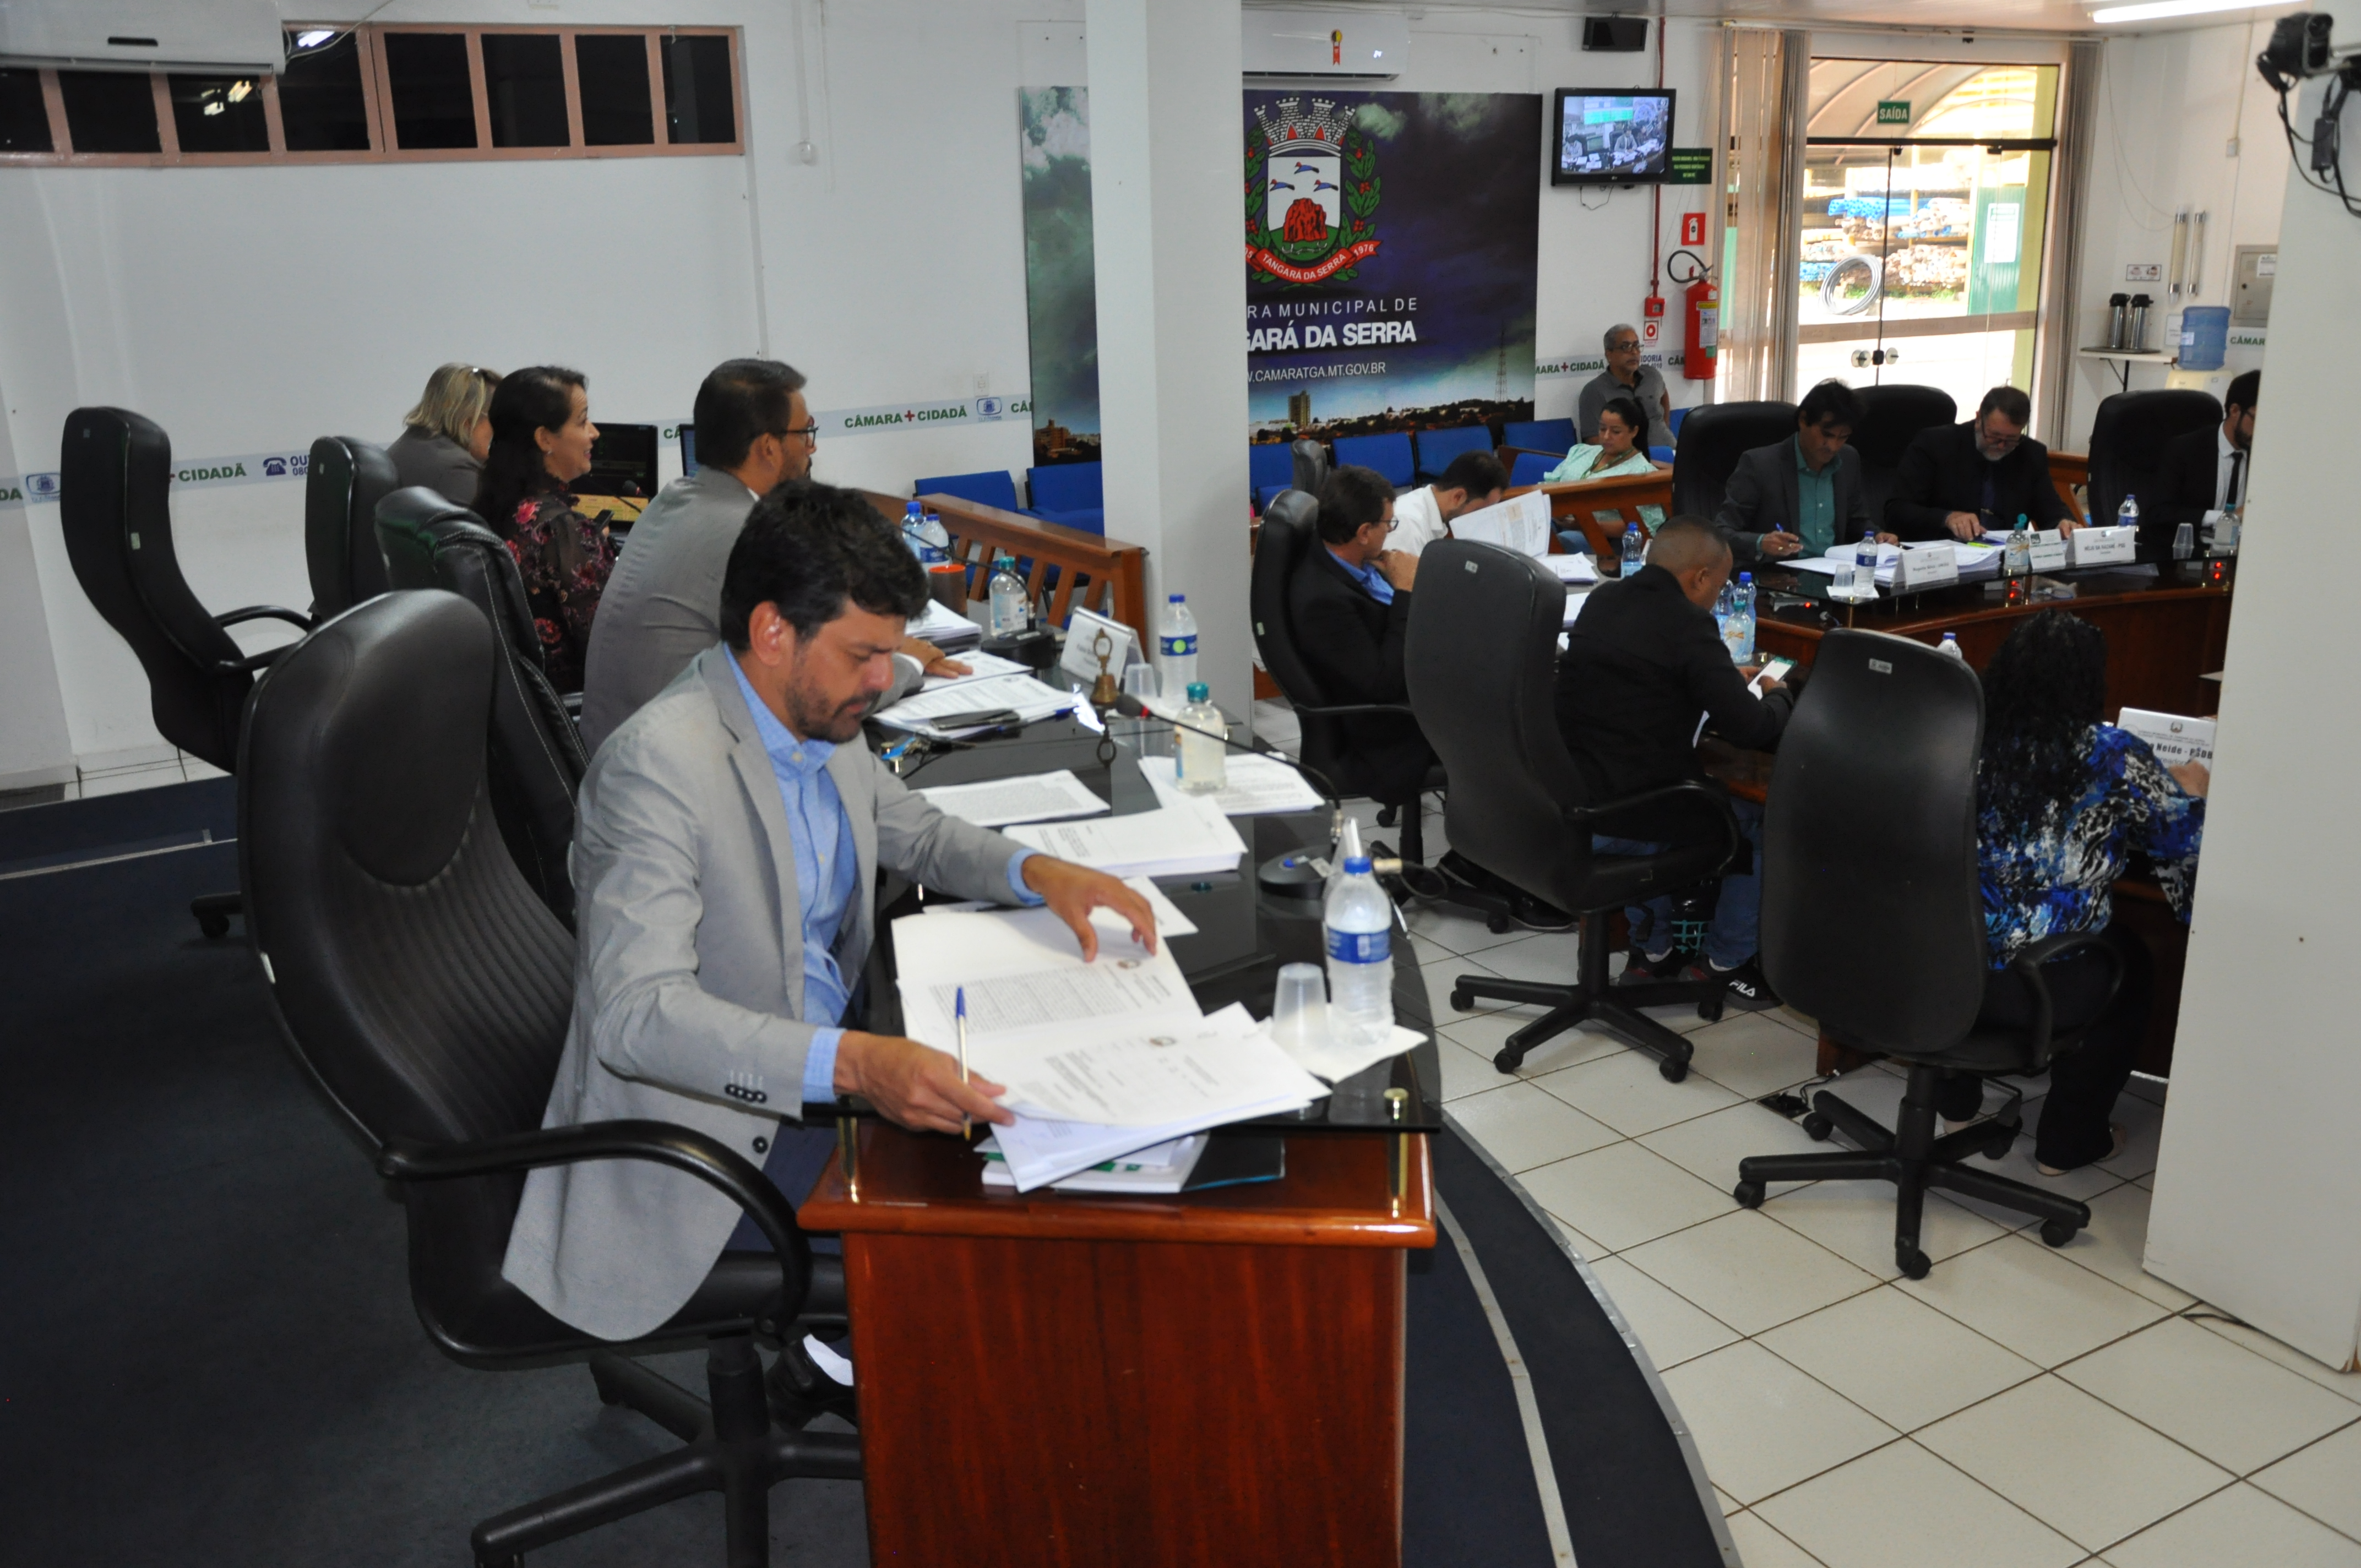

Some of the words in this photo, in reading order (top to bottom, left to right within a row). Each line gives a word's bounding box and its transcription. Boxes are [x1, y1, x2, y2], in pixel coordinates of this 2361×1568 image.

[1879, 106, 1908, 120] SAÍDA
[1263, 253, 1302, 280] TANGARÁ
[1303, 271, 1316, 280] DA
[1317, 253, 1346, 276] SERRA
[1353, 244, 1374, 256] 1976
[1247, 304, 1271, 319] RA
[1279, 299, 1388, 318] MUNICIPAL
[1395, 297, 1417, 312] DE
[1305, 325, 1337, 349] DA
[1342, 320, 1417, 346] SERRA
[1570, 358, 1604, 372] CIDADÃ
[844, 414, 903, 428] CÂMARA
[917, 405, 967, 421] CIDADÃ
[290, 455, 310, 467] OU
[178, 462, 247, 482] CIDADÃ
[2156, 743, 2182, 755] Neide
[1729, 979, 1756, 997] FILA
